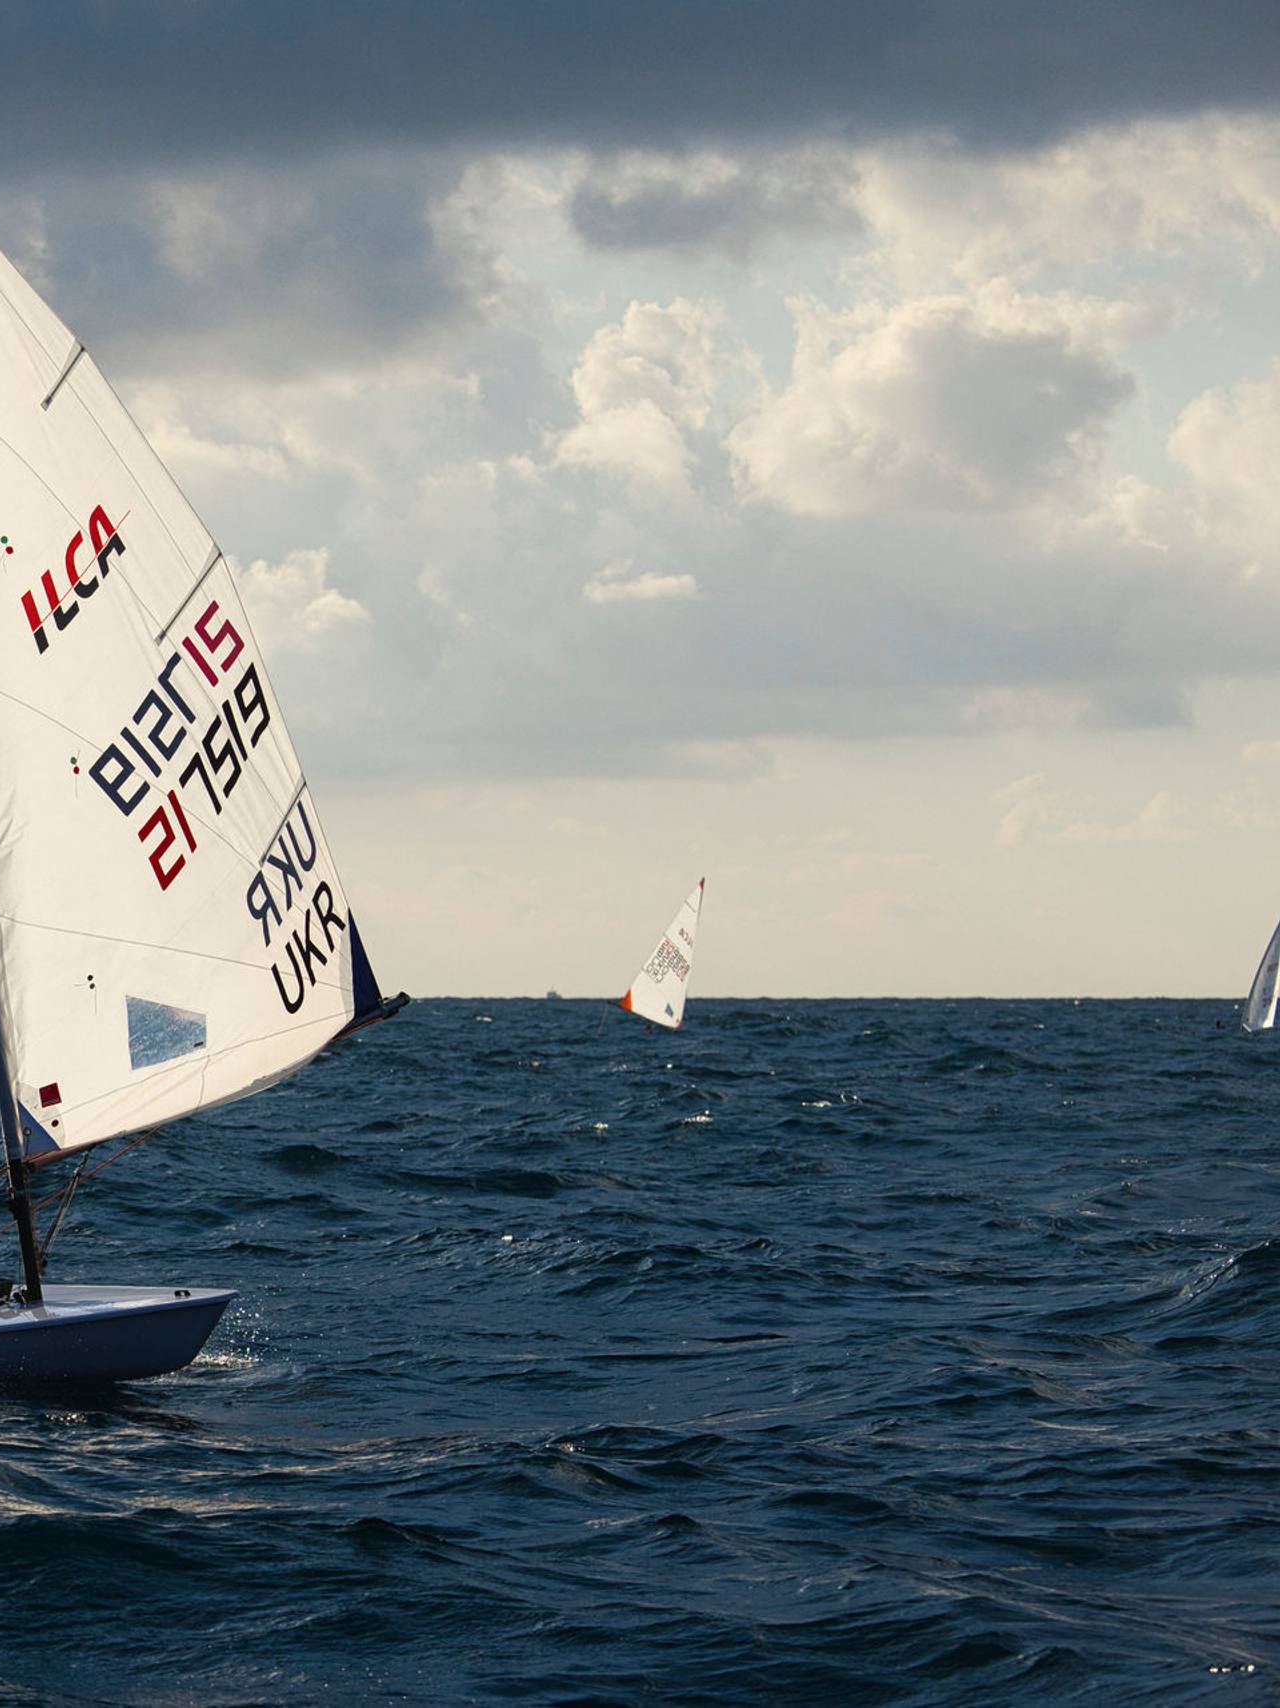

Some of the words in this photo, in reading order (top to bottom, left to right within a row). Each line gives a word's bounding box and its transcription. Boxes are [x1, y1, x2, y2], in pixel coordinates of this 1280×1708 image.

[21, 505, 126, 654] ILCA
[138, 662, 270, 891] 217519
[271, 881, 346, 1014] UKR
